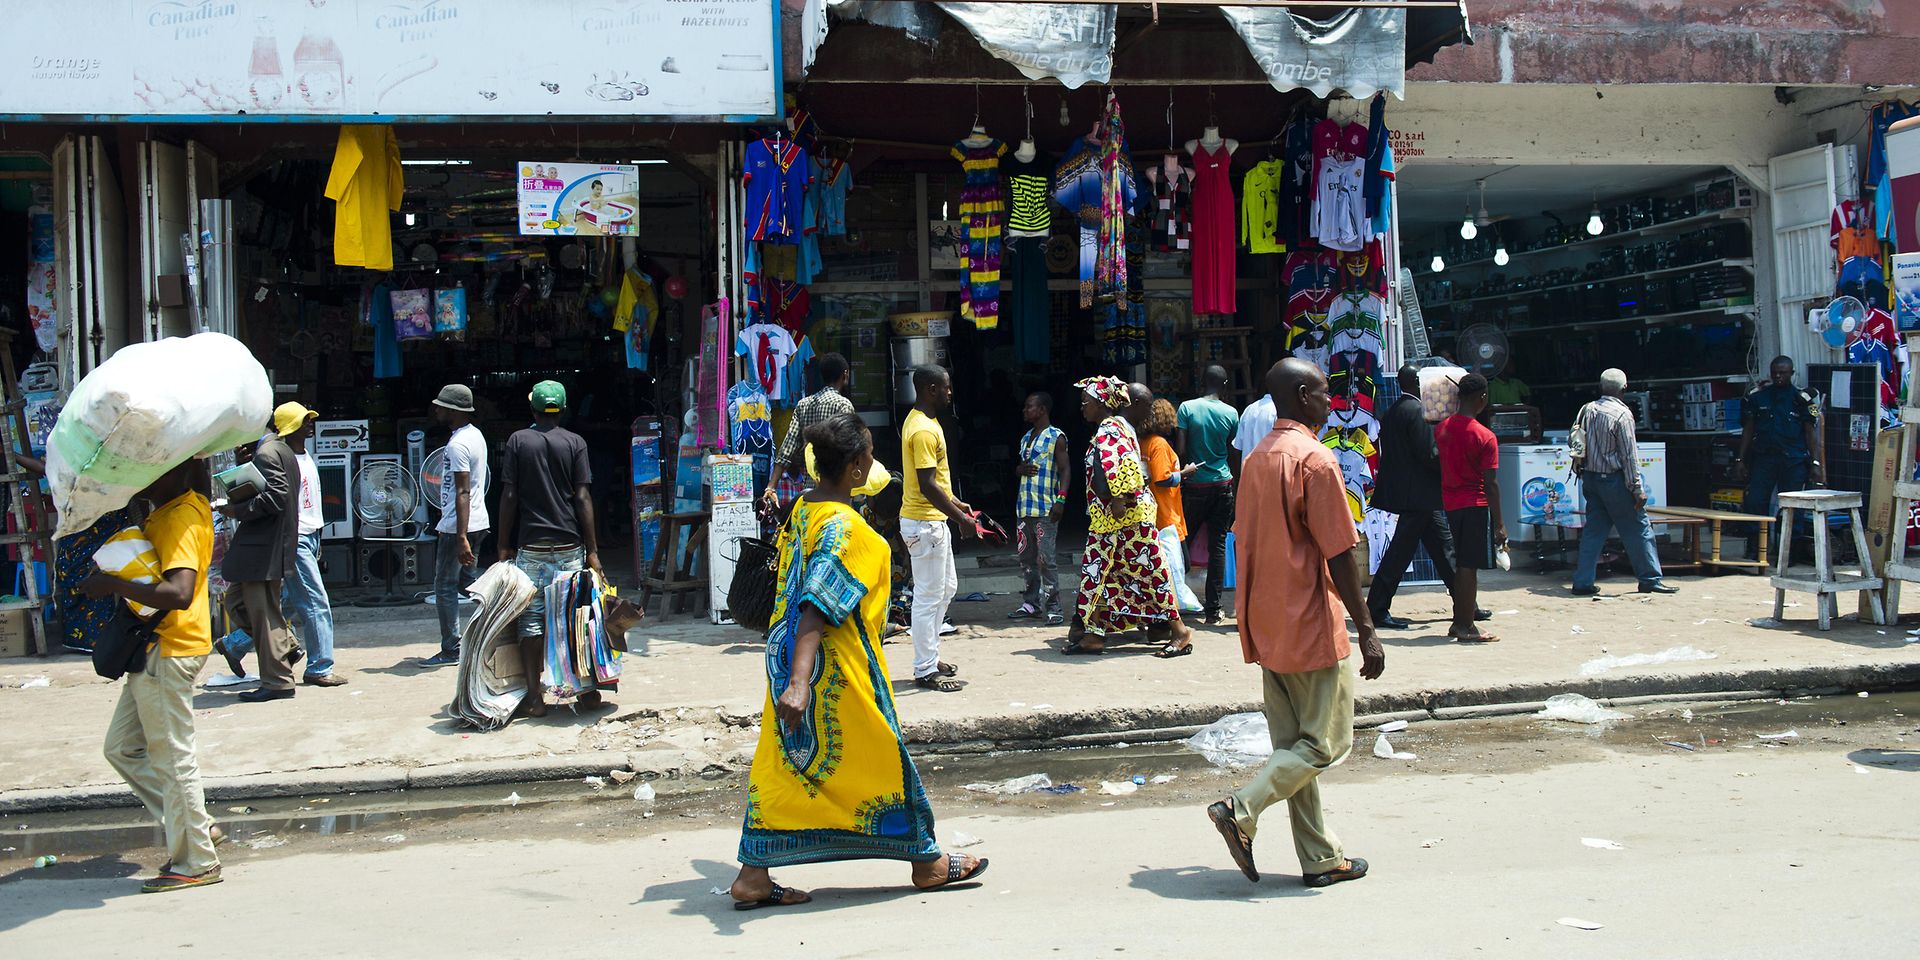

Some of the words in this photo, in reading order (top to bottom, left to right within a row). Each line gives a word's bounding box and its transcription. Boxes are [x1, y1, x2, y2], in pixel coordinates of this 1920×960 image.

[148, 3, 236, 28] Canadian
[375, 7, 459, 30] Canadian
[582, 11, 662, 32] Canadian
[701, 7, 726, 15] WITH
[681, 17, 750, 27] HAZELNUTS
[32, 55, 102, 72] Orange
[994, 48, 1051, 71] enue
[1056, 52, 1083, 73] du
